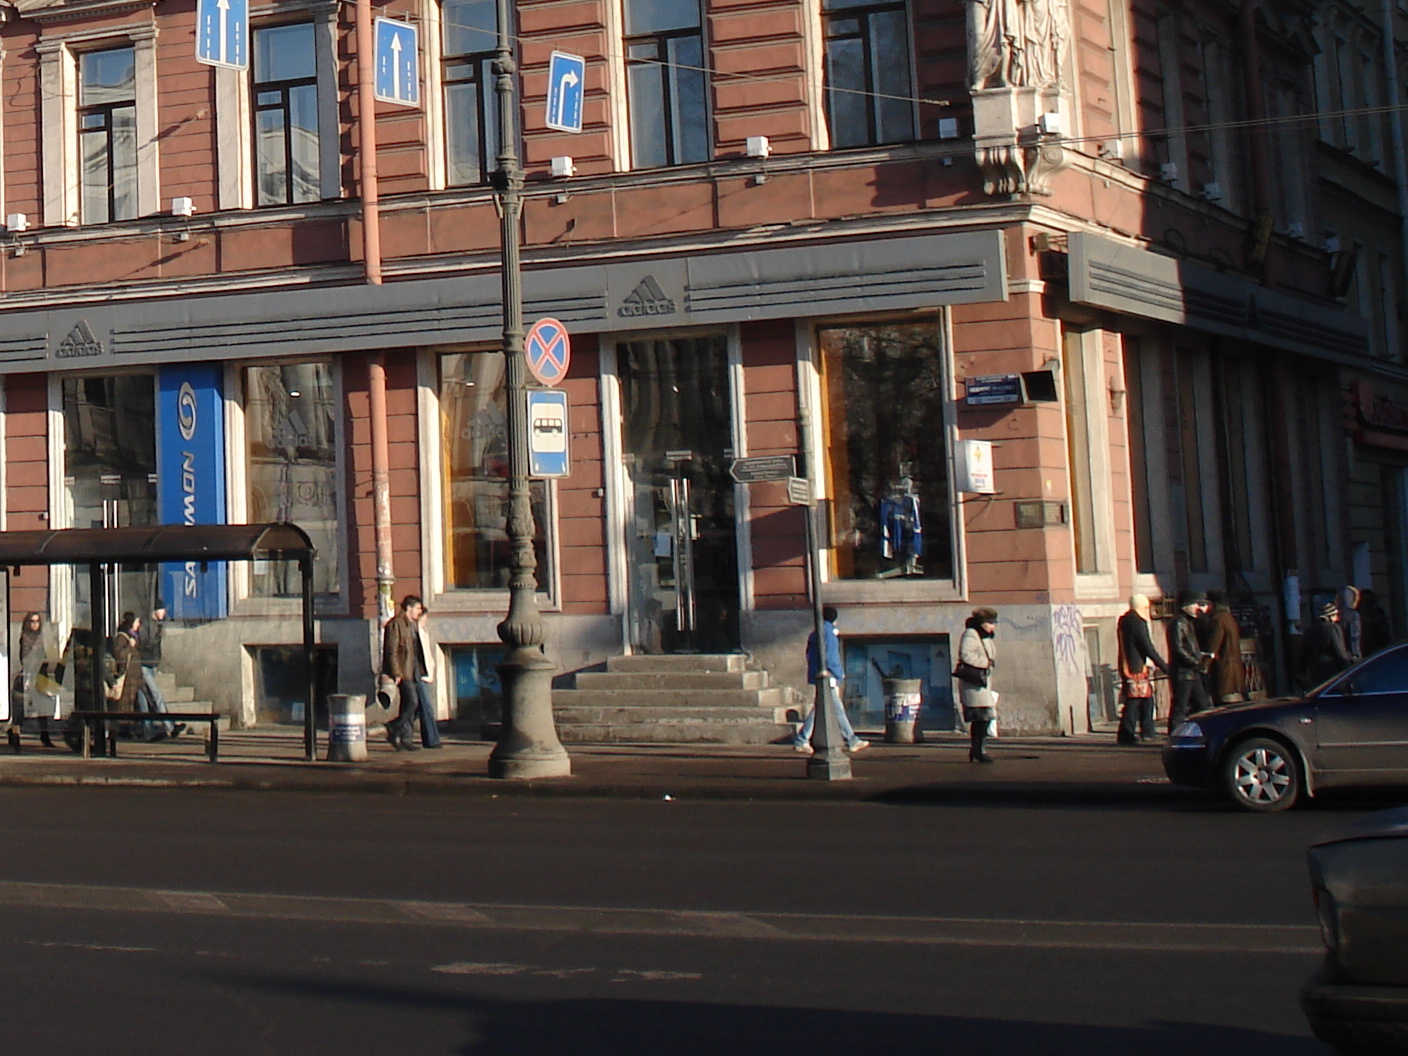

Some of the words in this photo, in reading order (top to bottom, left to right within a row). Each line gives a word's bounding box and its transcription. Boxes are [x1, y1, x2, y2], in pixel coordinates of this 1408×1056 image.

[617, 299, 678, 317] adidas
[55, 341, 104, 359] adidas
[181, 452, 197, 598] SAMON
